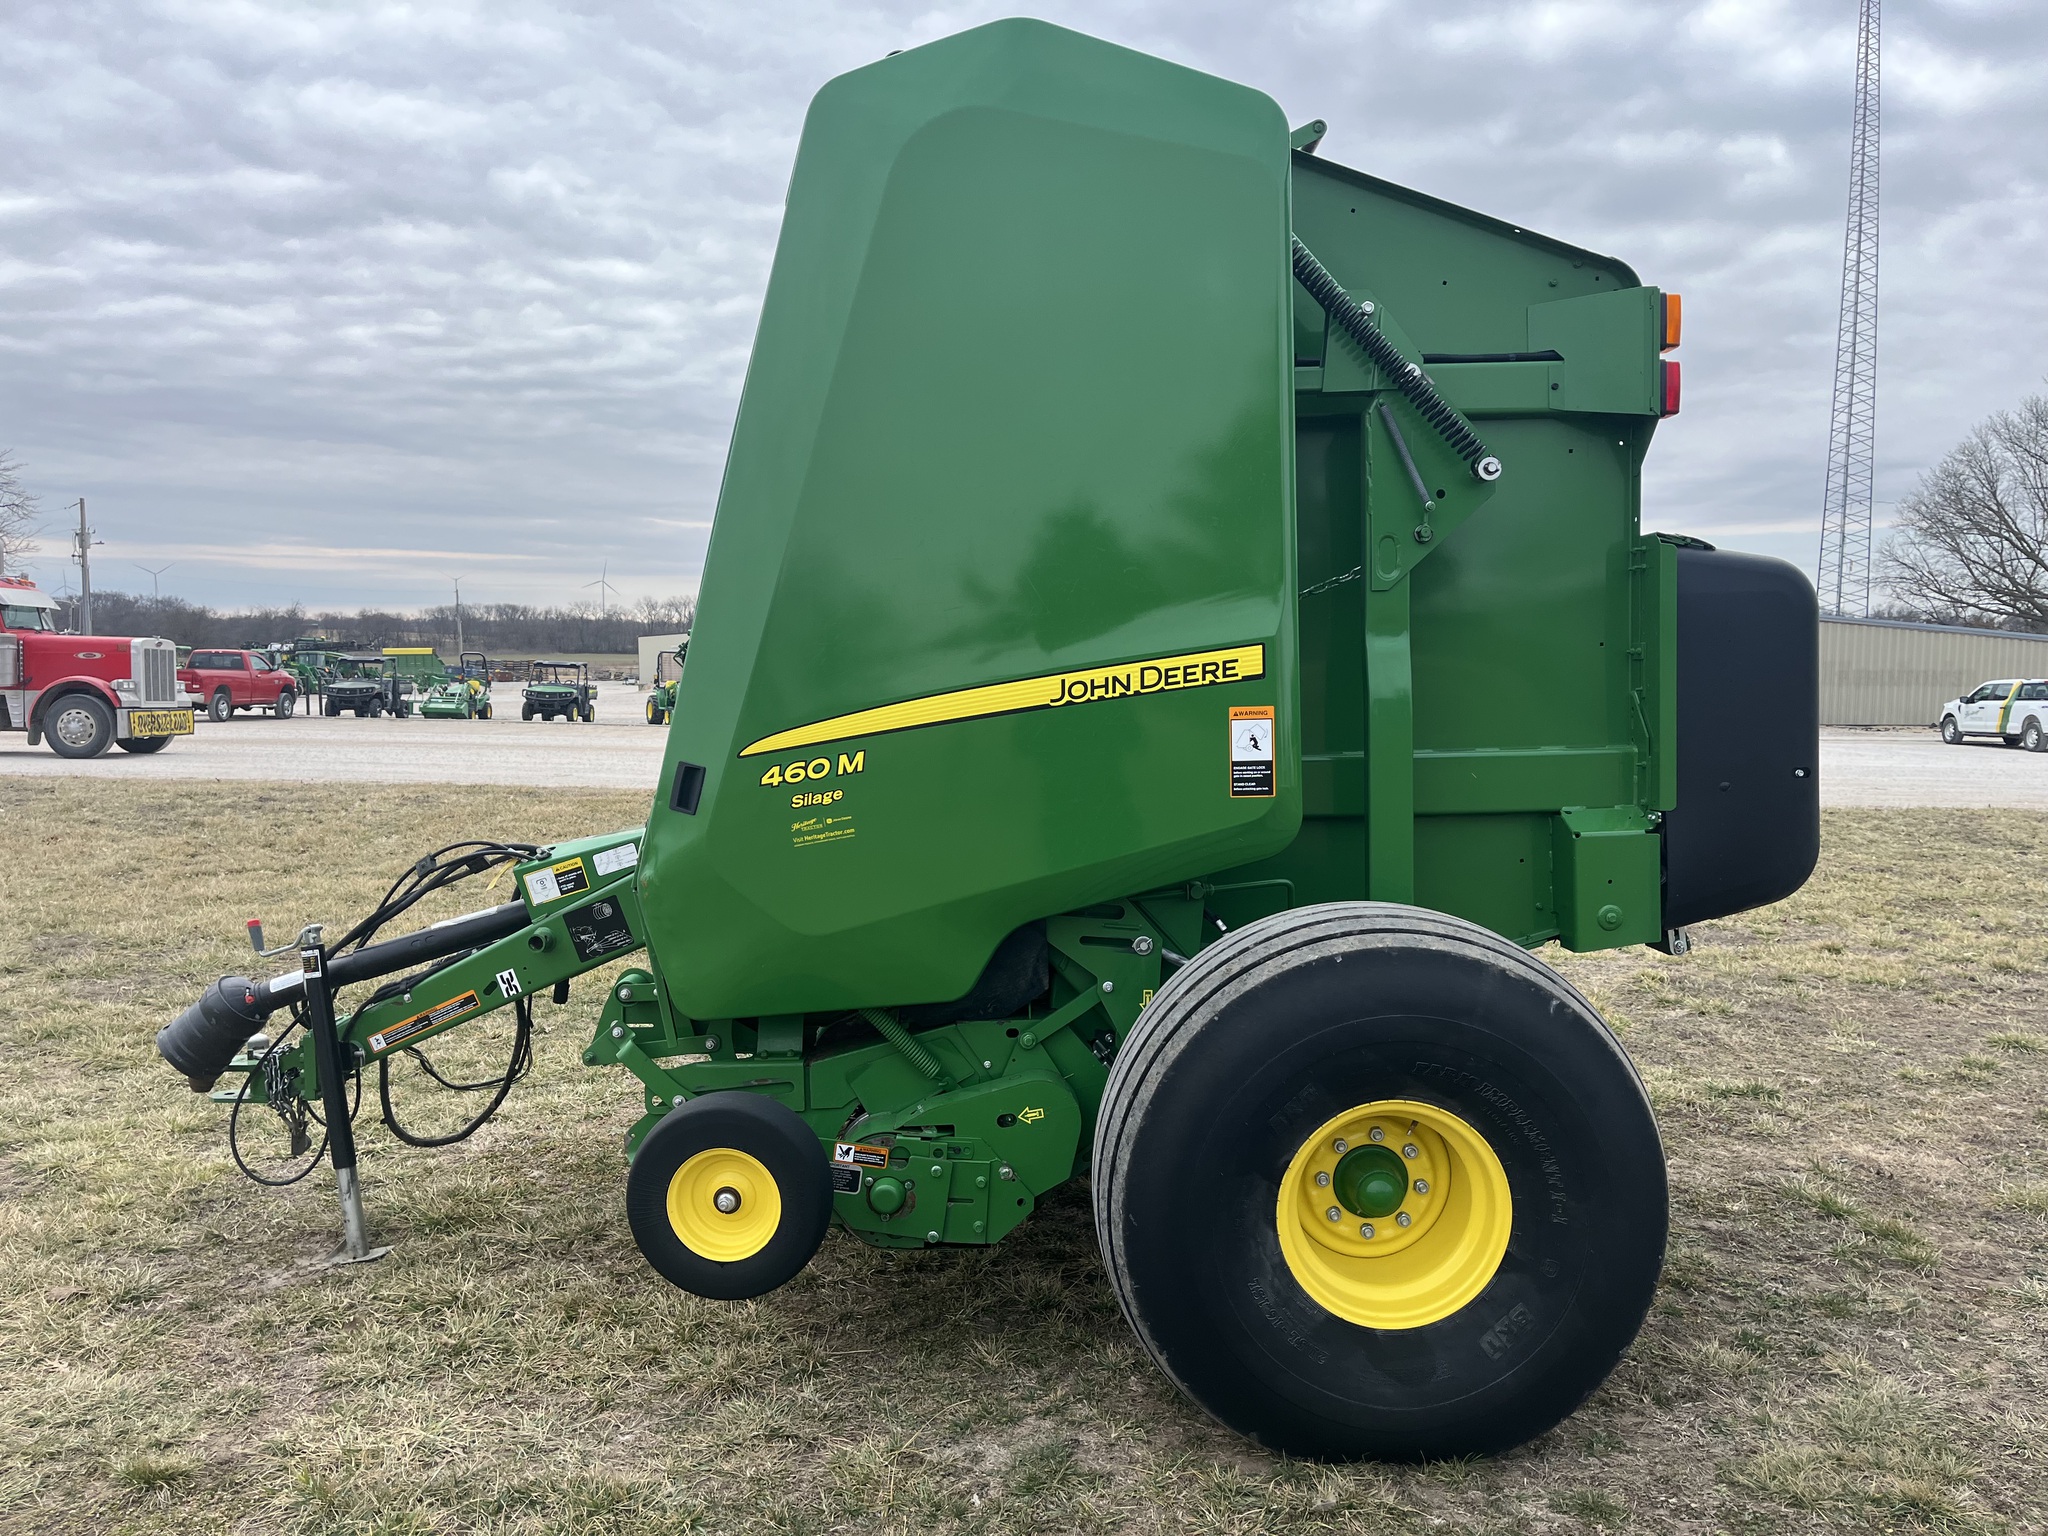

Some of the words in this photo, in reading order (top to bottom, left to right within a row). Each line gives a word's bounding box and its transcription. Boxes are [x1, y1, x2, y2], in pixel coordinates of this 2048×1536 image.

[1049, 673, 1131, 703] JOHN
[1140, 659, 1239, 690] DEERE
[759, 757, 832, 788] 460
[836, 749, 866, 777] M
[790, 788, 844, 810] Silage
[804, 828, 855, 842] HeritageTractor.com
[559, 861, 579, 871] CAUTION
